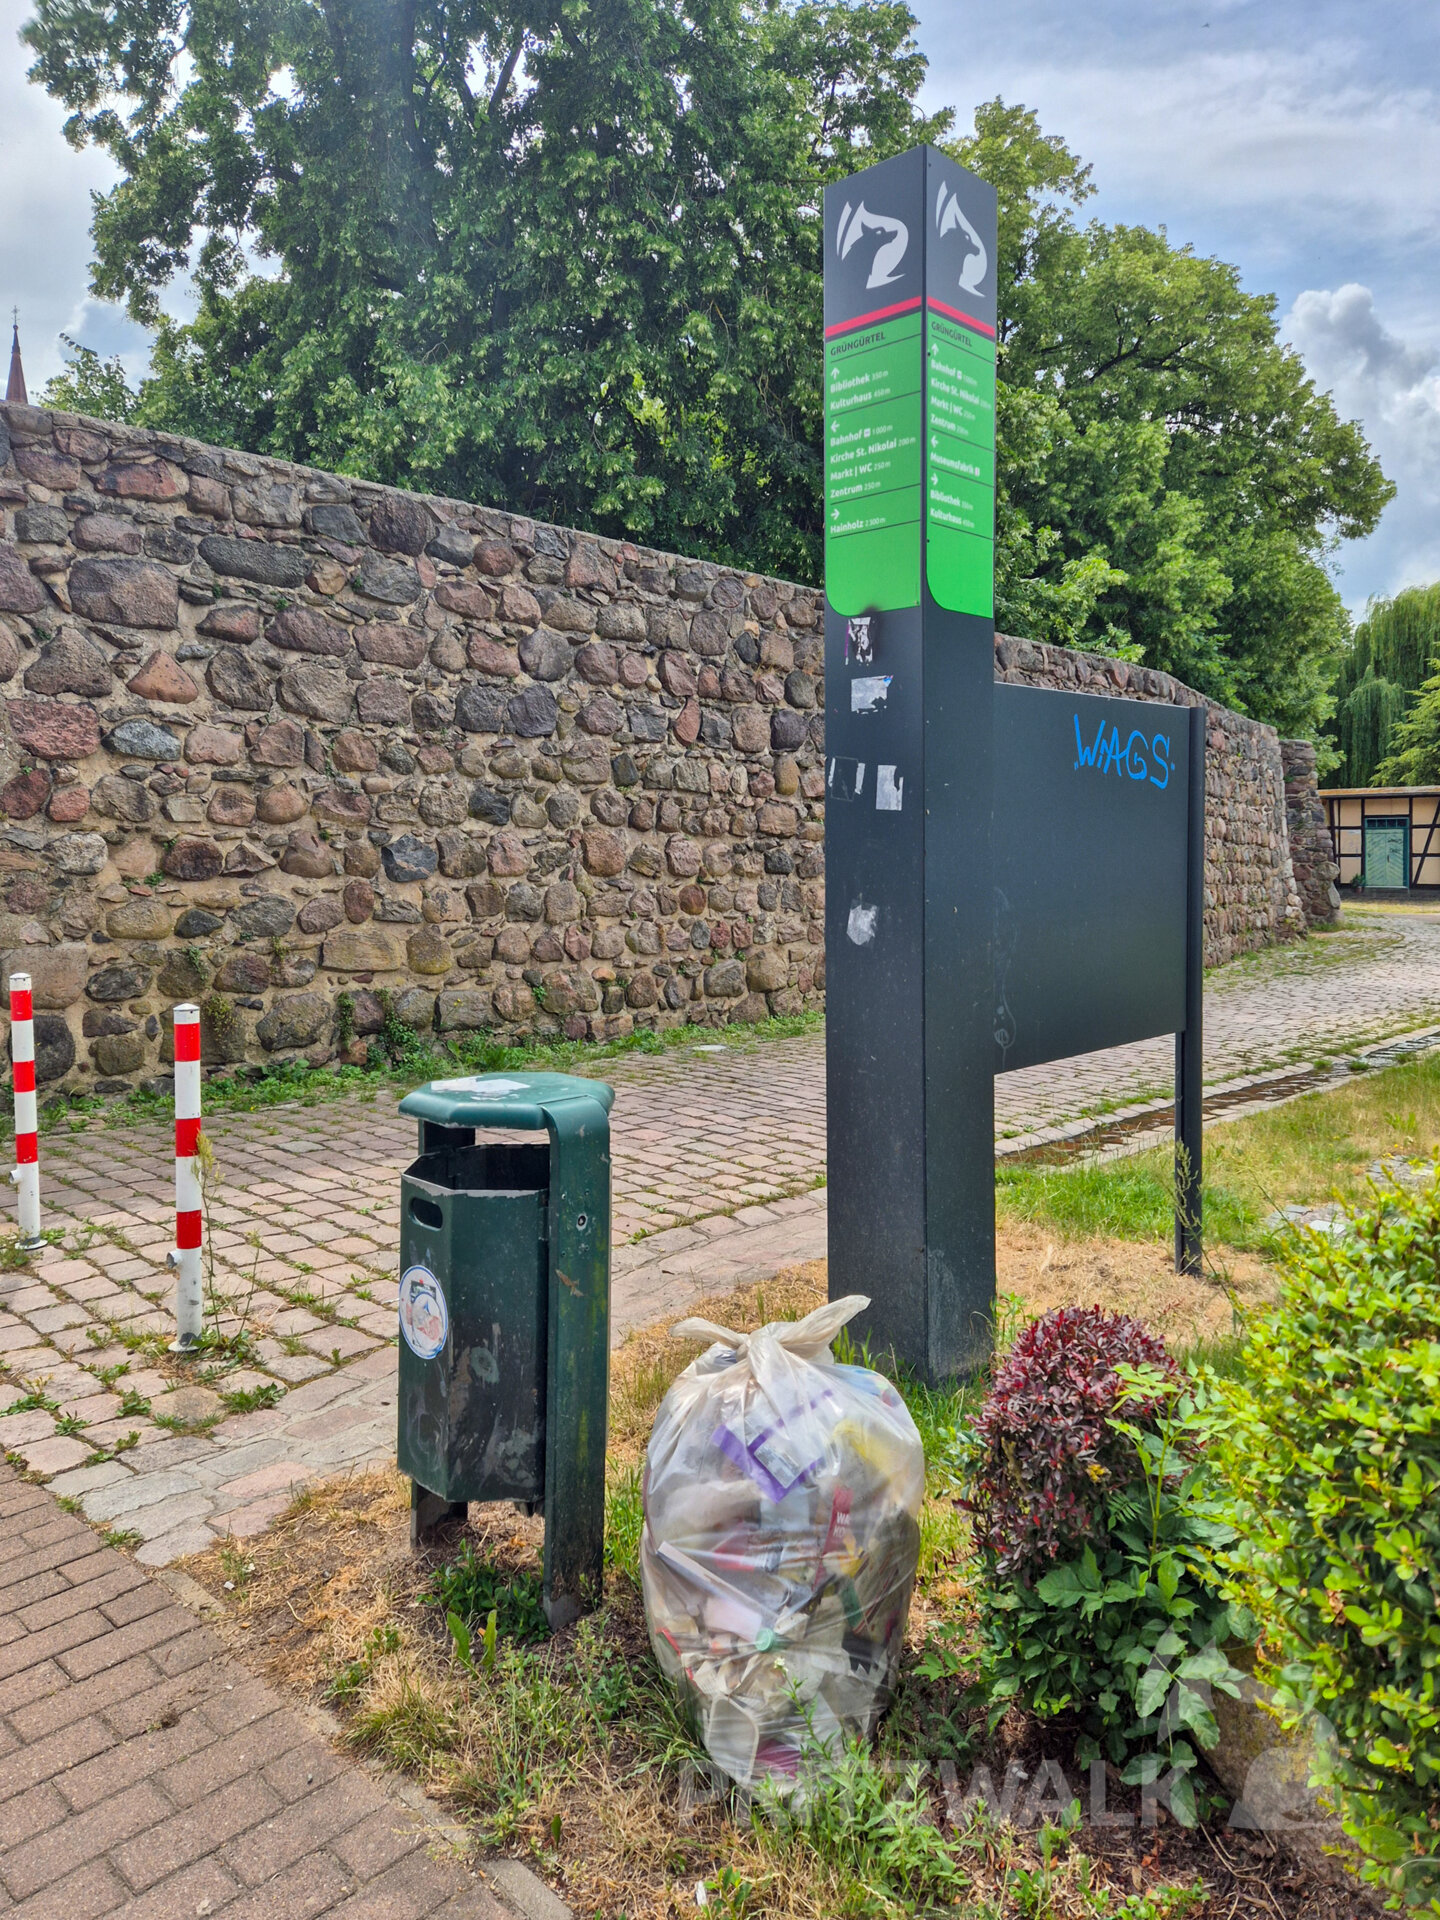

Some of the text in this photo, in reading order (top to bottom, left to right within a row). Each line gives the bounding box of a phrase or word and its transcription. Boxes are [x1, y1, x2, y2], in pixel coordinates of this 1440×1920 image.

[830, 331, 885, 356] GRÜNGÜRTEL
[931, 321, 972, 347] GRÜNGÜRTEL
[830, 373, 870, 393] Bibliothek
[830, 392, 872, 410] Kulturhaus
[830, 429, 862, 447] Bahnhof
[830, 451, 854, 464] Kirche
[856, 448, 867, 457] St.
[868, 438, 897, 454] Nikolai
[830, 468, 853, 481] Markt
[859, 462, 872, 474] WC
[830, 483, 863, 498] Zentrum
[830, 520, 864, 534] Hainholz
